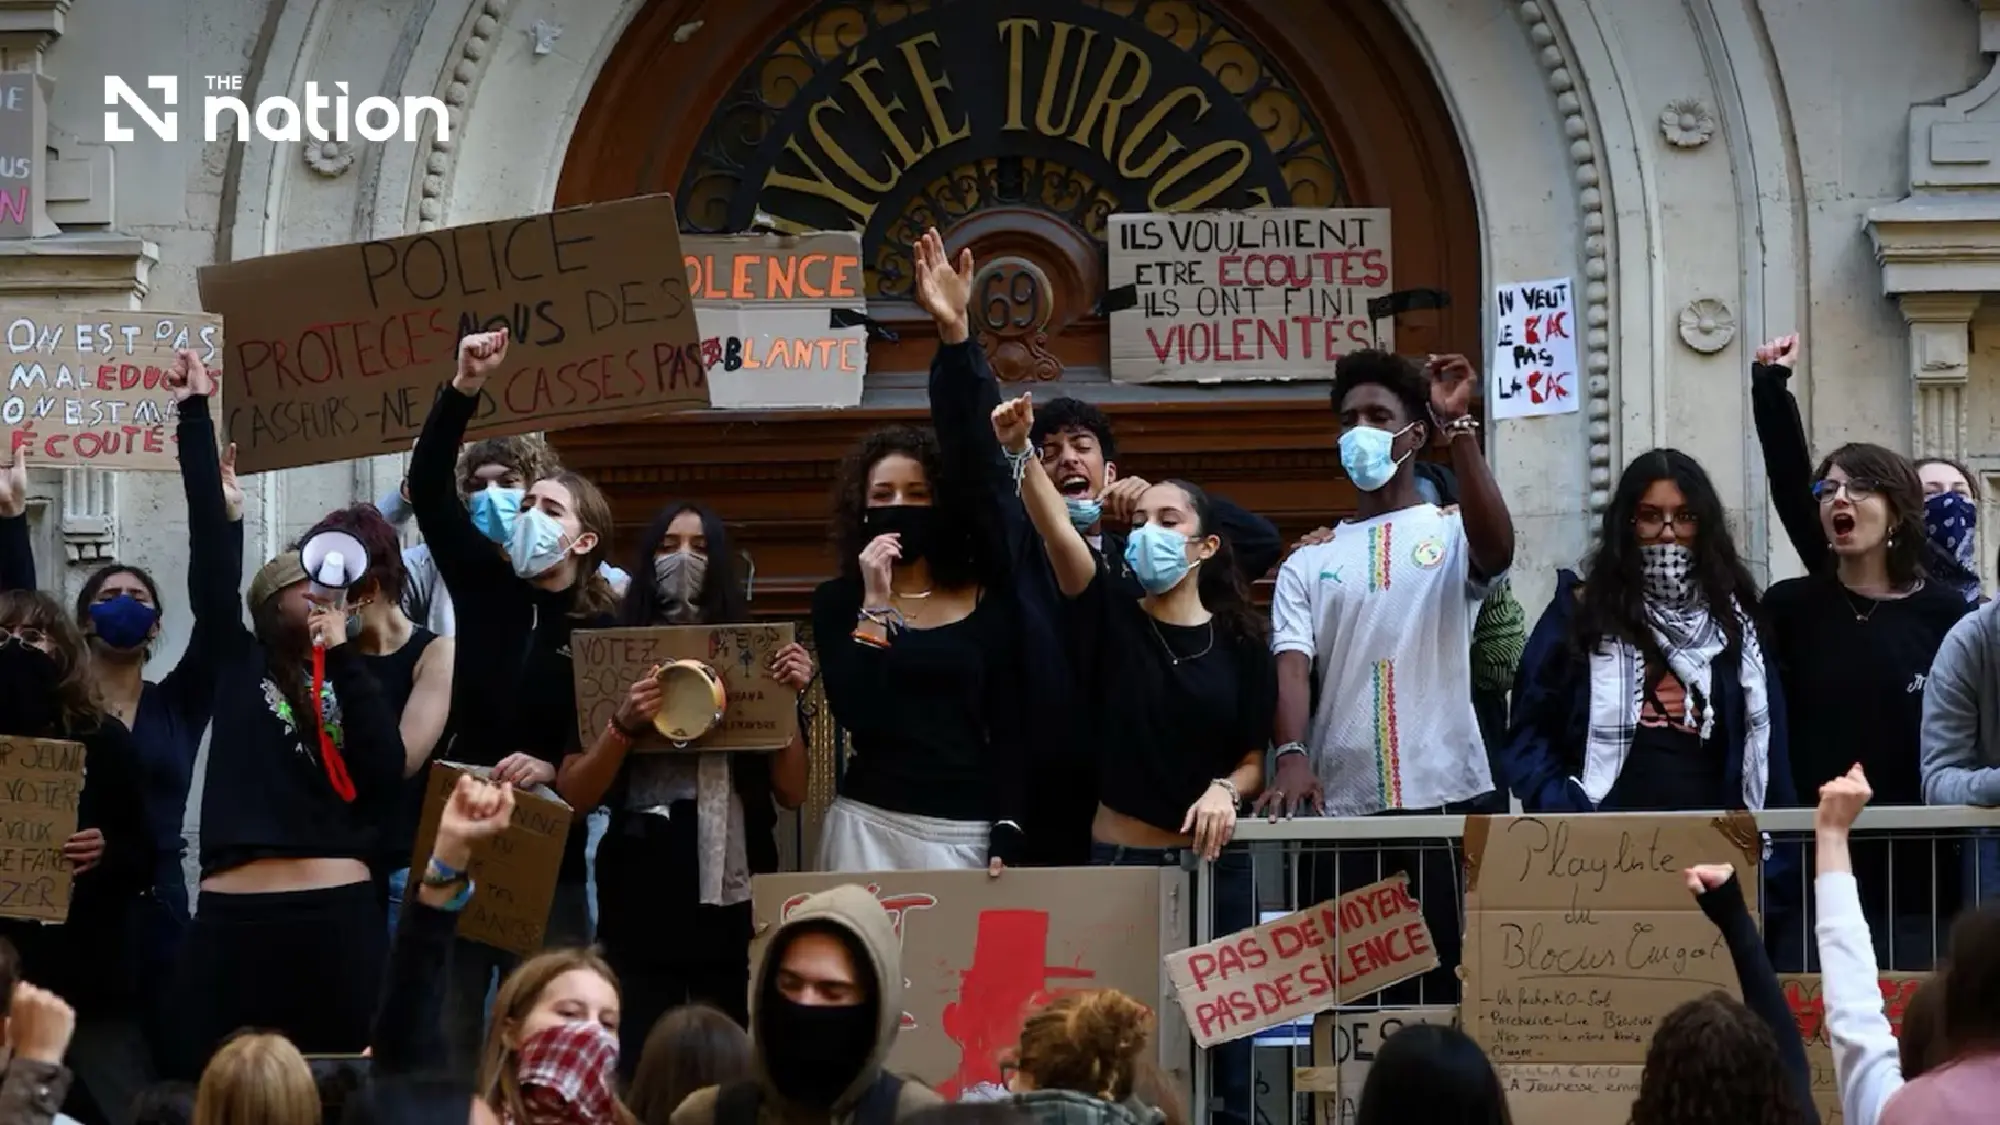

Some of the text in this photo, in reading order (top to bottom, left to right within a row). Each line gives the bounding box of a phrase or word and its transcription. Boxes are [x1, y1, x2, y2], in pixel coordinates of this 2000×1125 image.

[997, 18, 1272, 213] TURGO
[1120, 218, 1374, 252] ILS VOULAIENT
[360, 209, 595, 308] POLICE
[1136, 244, 1388, 288] ETRE ÉCOUTÉS
[585, 277, 685, 335] DES
[981, 270, 1037, 329] 69
[1145, 287, 1353, 318] ILS ONT FINI
[1521, 283, 1568, 311] VEUT
[8, 318, 219, 363] ON EST PAS
[1146, 314, 1370, 365] VIOLENTÉS
[1524, 311, 1569, 345] BAC
[504, 349, 646, 414] CASSES
[653, 342, 706, 393] PAS
[1513, 344, 1554, 369] PAS
[1499, 370, 1571, 405] LA BAC
[2, 396, 181, 428] ON EST MA
[11, 421, 178, 460] ÉCOUTÉ
[578, 637, 659, 667] VOTEZ
[1507, 816, 1679, 892] Playliste
[1564, 883, 1600, 925] du
[1187, 882, 1419, 991] PAS DE MOYEN
[1500, 923, 1616, 971] Blocus
[1195, 991, 1257, 1038] PAS
[1253, 973, 1303, 1016] DE
